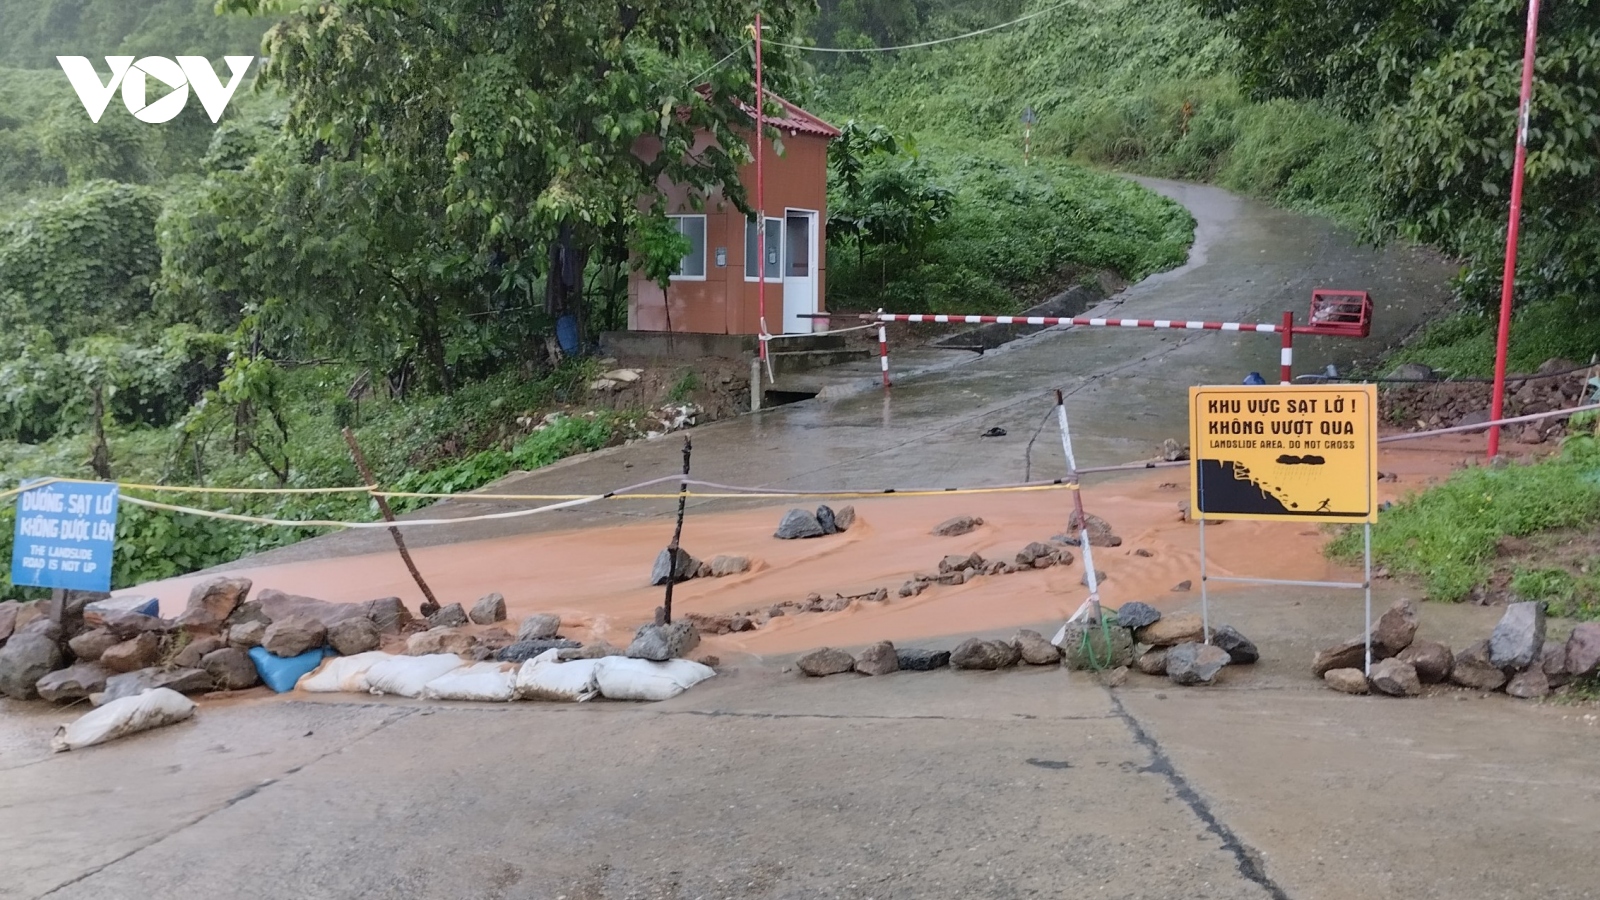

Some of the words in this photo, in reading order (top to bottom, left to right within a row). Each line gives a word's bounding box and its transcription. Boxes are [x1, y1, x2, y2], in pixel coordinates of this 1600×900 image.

[1208, 399, 1241, 414] KHU
[1247, 398, 1280, 417] VỰC
[1286, 399, 1318, 417] SẠT
[1324, 395, 1344, 414] LỞ
[1208, 418, 1264, 435] KHÔNG
[1271, 419, 1314, 438] VƯỢT
[1320, 420, 1354, 436] QUA
[1209, 439, 1257, 449] LANDSLIDE
[1289, 440, 1301, 449] DO
[1304, 440, 1321, 449] NOT
[1324, 440, 1355, 449] CROSS
[68, 493, 93, 517] SẠT
[20, 515, 59, 538] KHÔNG
[91, 519, 116, 542] LÊN
[30, 544, 46, 556] THE
[48, 546, 93, 560] LANDSLIDE
[22, 556, 45, 569] ROAD
[48, 559, 58, 570] IS
[61, 560, 81, 572] NOT
[83, 562, 97, 573] UP
